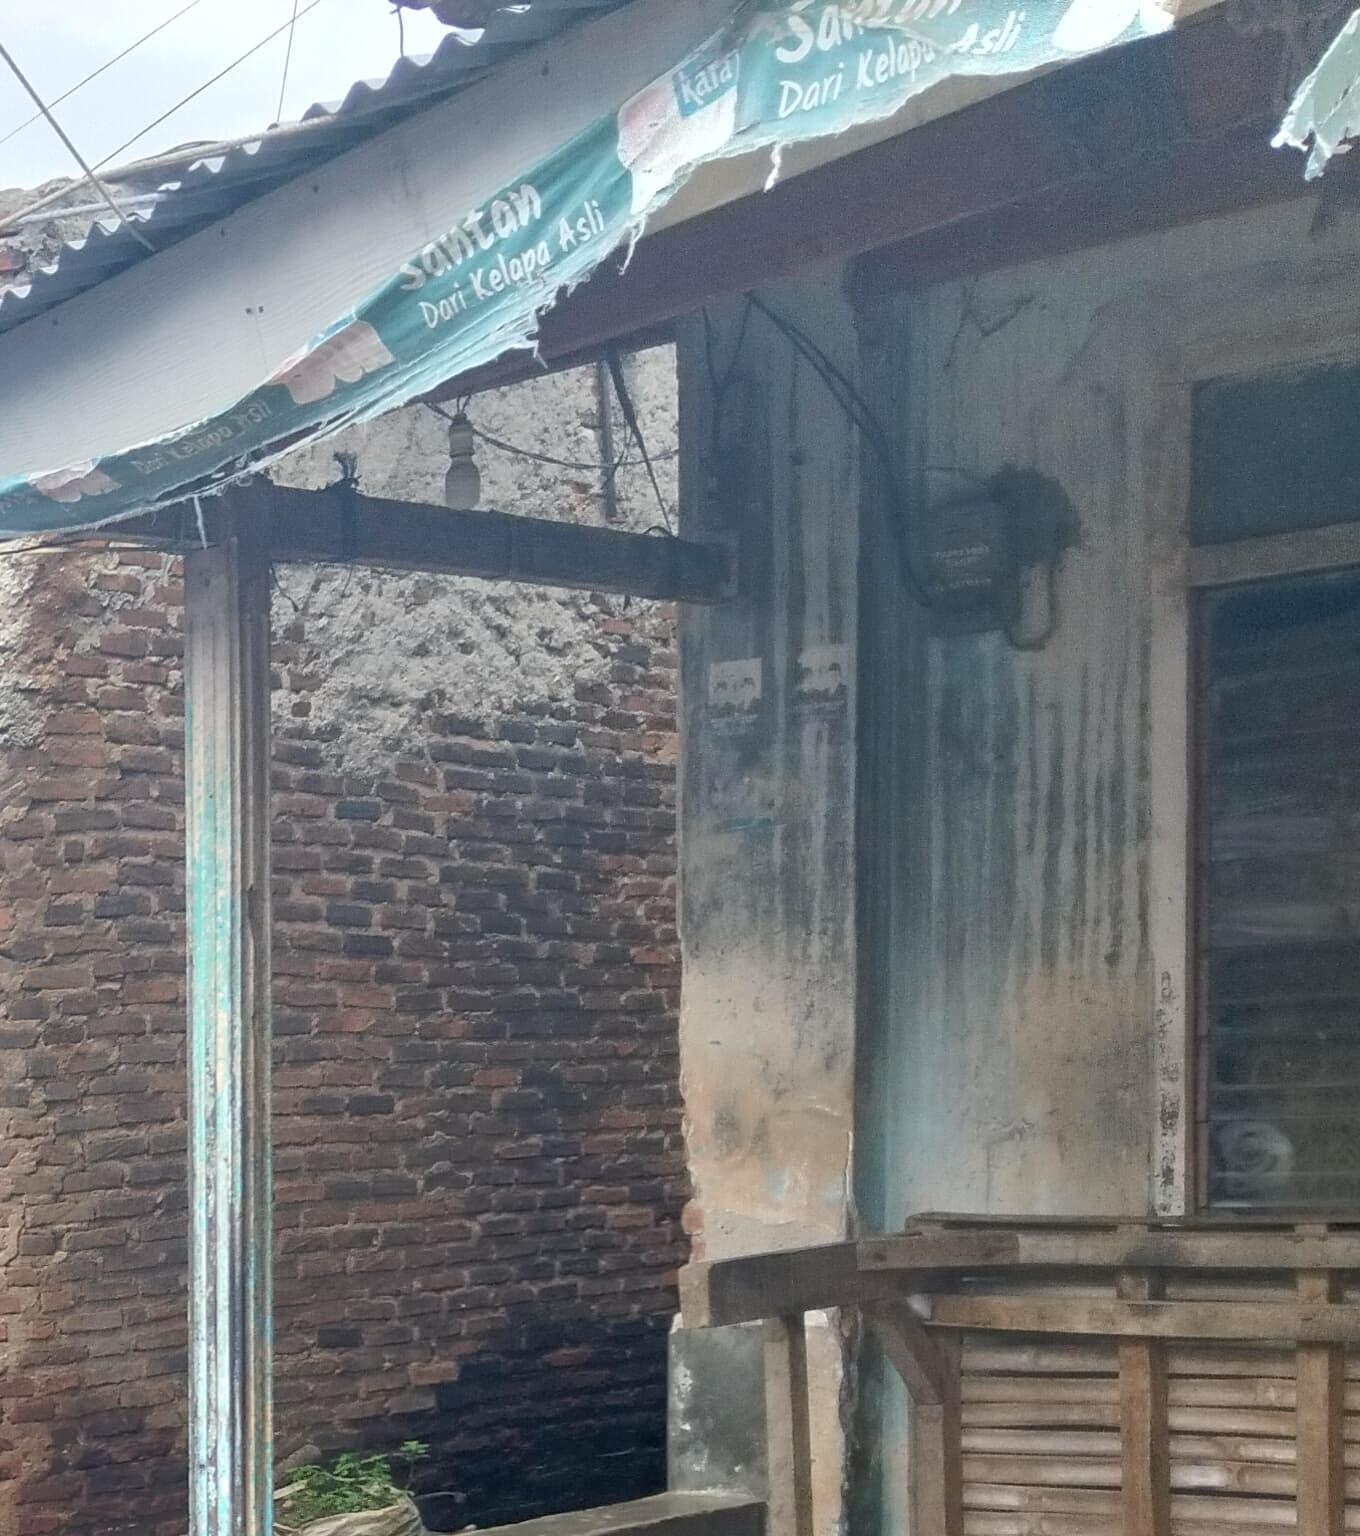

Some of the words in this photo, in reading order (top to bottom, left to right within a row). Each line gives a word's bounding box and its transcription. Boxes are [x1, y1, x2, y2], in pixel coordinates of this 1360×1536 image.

[779, 62, 843, 118] Dari
[857, 35, 937, 90] Kelapa
[951, 10, 1027, 55] Asli
[419, 283, 468, 329] Dari
[469, 240, 551, 301] Kelapa
[559, 199, 605, 252] Asli
